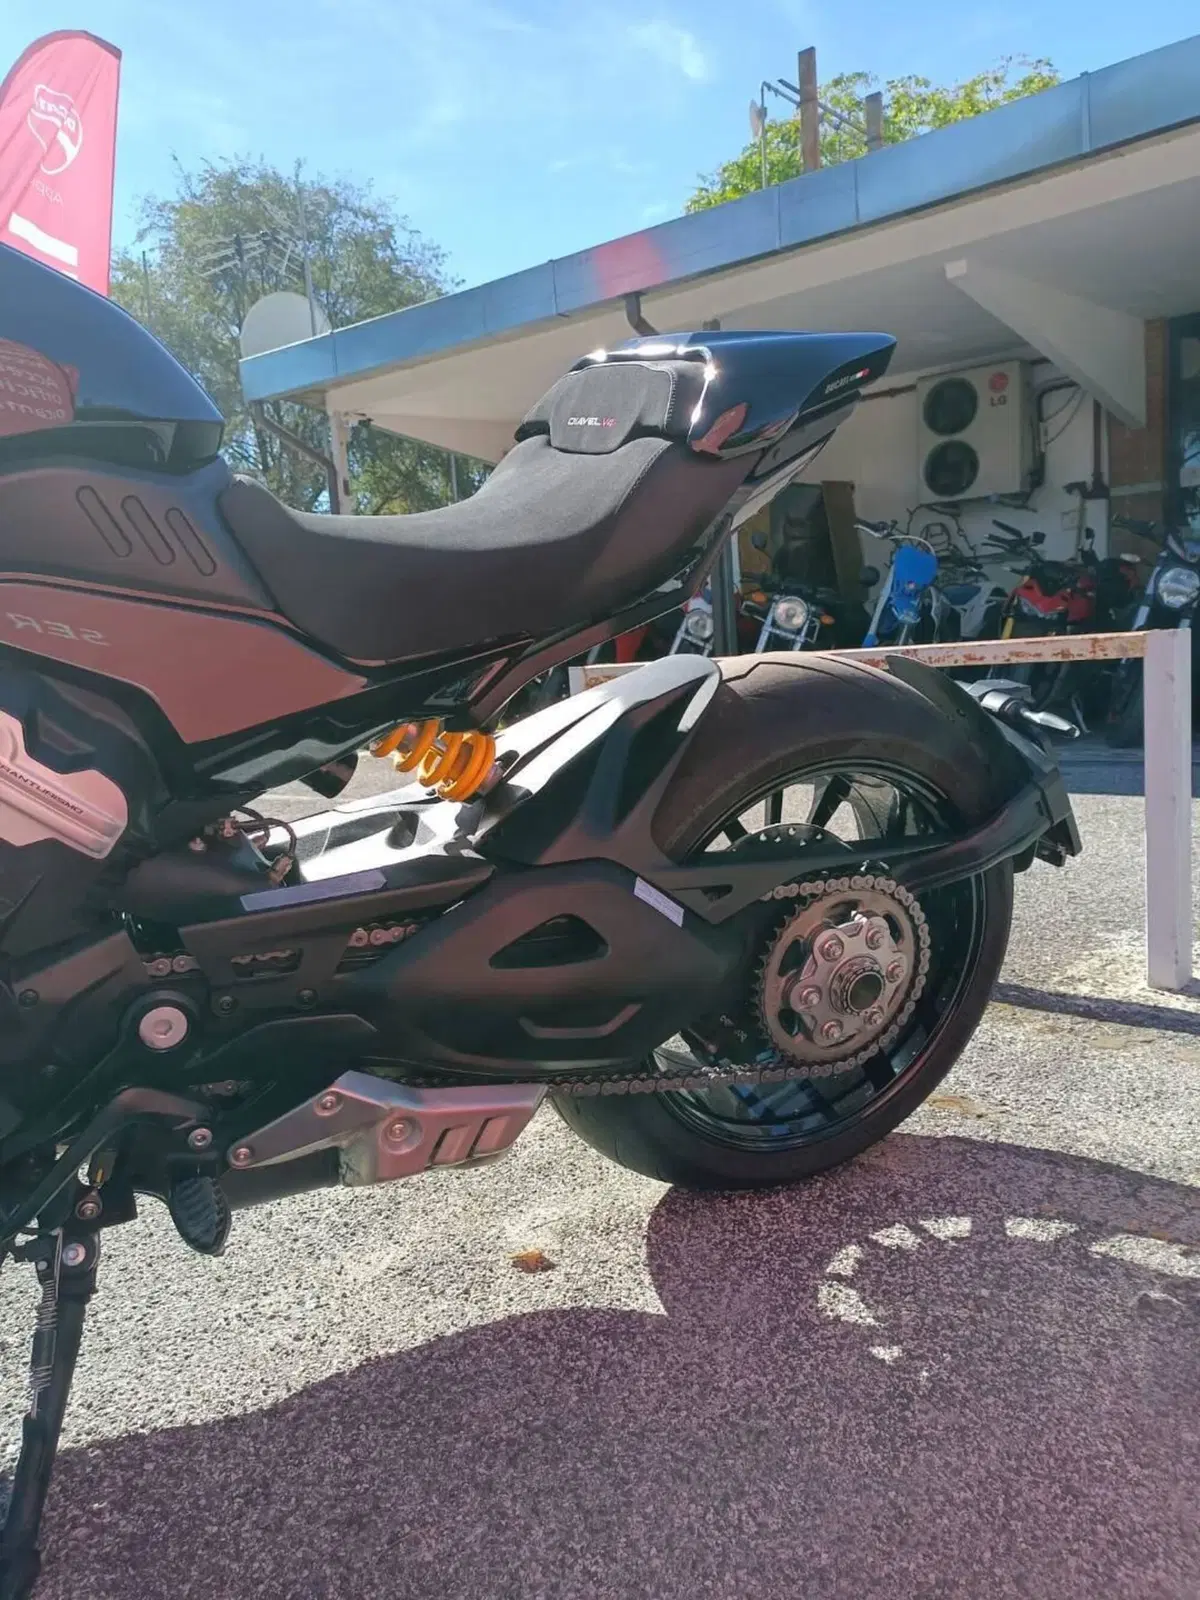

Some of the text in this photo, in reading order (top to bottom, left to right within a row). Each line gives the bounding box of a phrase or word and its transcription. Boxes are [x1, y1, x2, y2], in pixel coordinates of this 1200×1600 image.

[990, 395, 1007, 407] LG
[568, 417, 601, 427] DIAVEL
[0, 763, 84, 815] RANTURISMO
